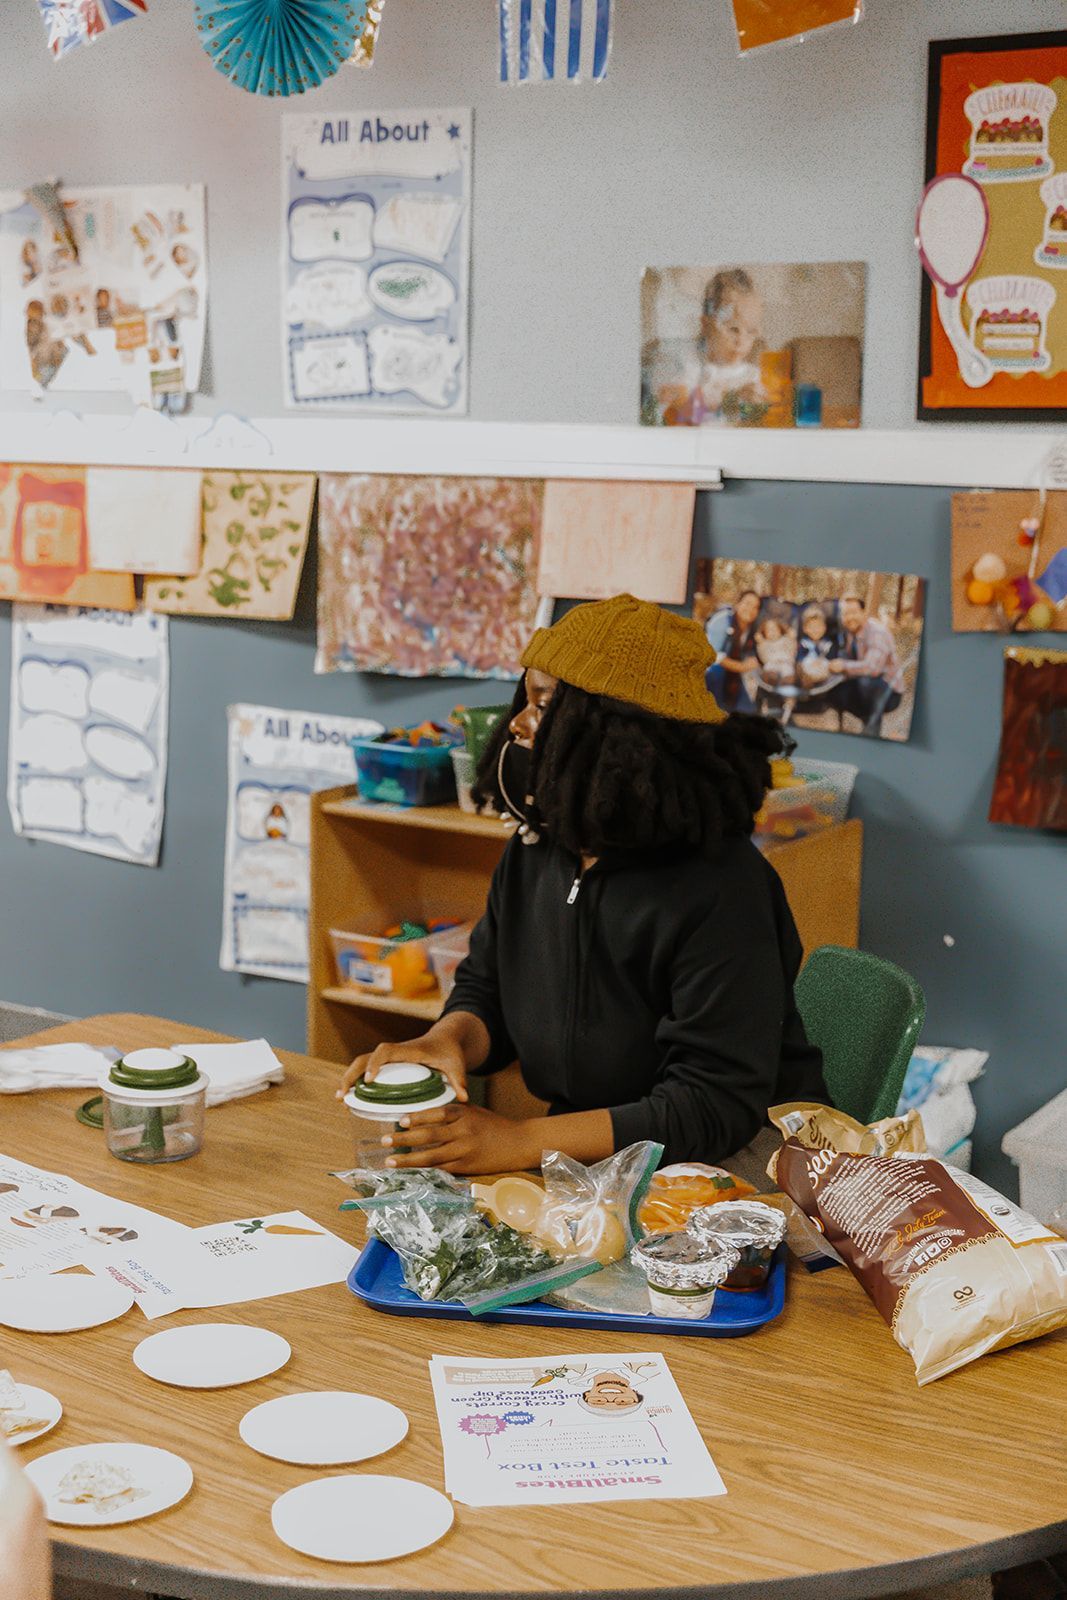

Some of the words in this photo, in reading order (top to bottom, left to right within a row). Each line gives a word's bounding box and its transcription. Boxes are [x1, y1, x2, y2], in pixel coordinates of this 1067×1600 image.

[320, 119, 348, 143] All
[360, 117, 430, 142] About
[264, 718, 290, 738] All
[450, 1396, 491, 1404] Green
[495, 1394, 546, 1402] Groovy
[465, 1401, 521, 1409] Carrots
[525, 1400, 566, 1408] Crazy
[549, 1459, 600, 1471] Test
[605, 1456, 671, 1467] Taste
[497, 1462, 543, 1473] Box
[514, 1474, 662, 1490] SmallBites
